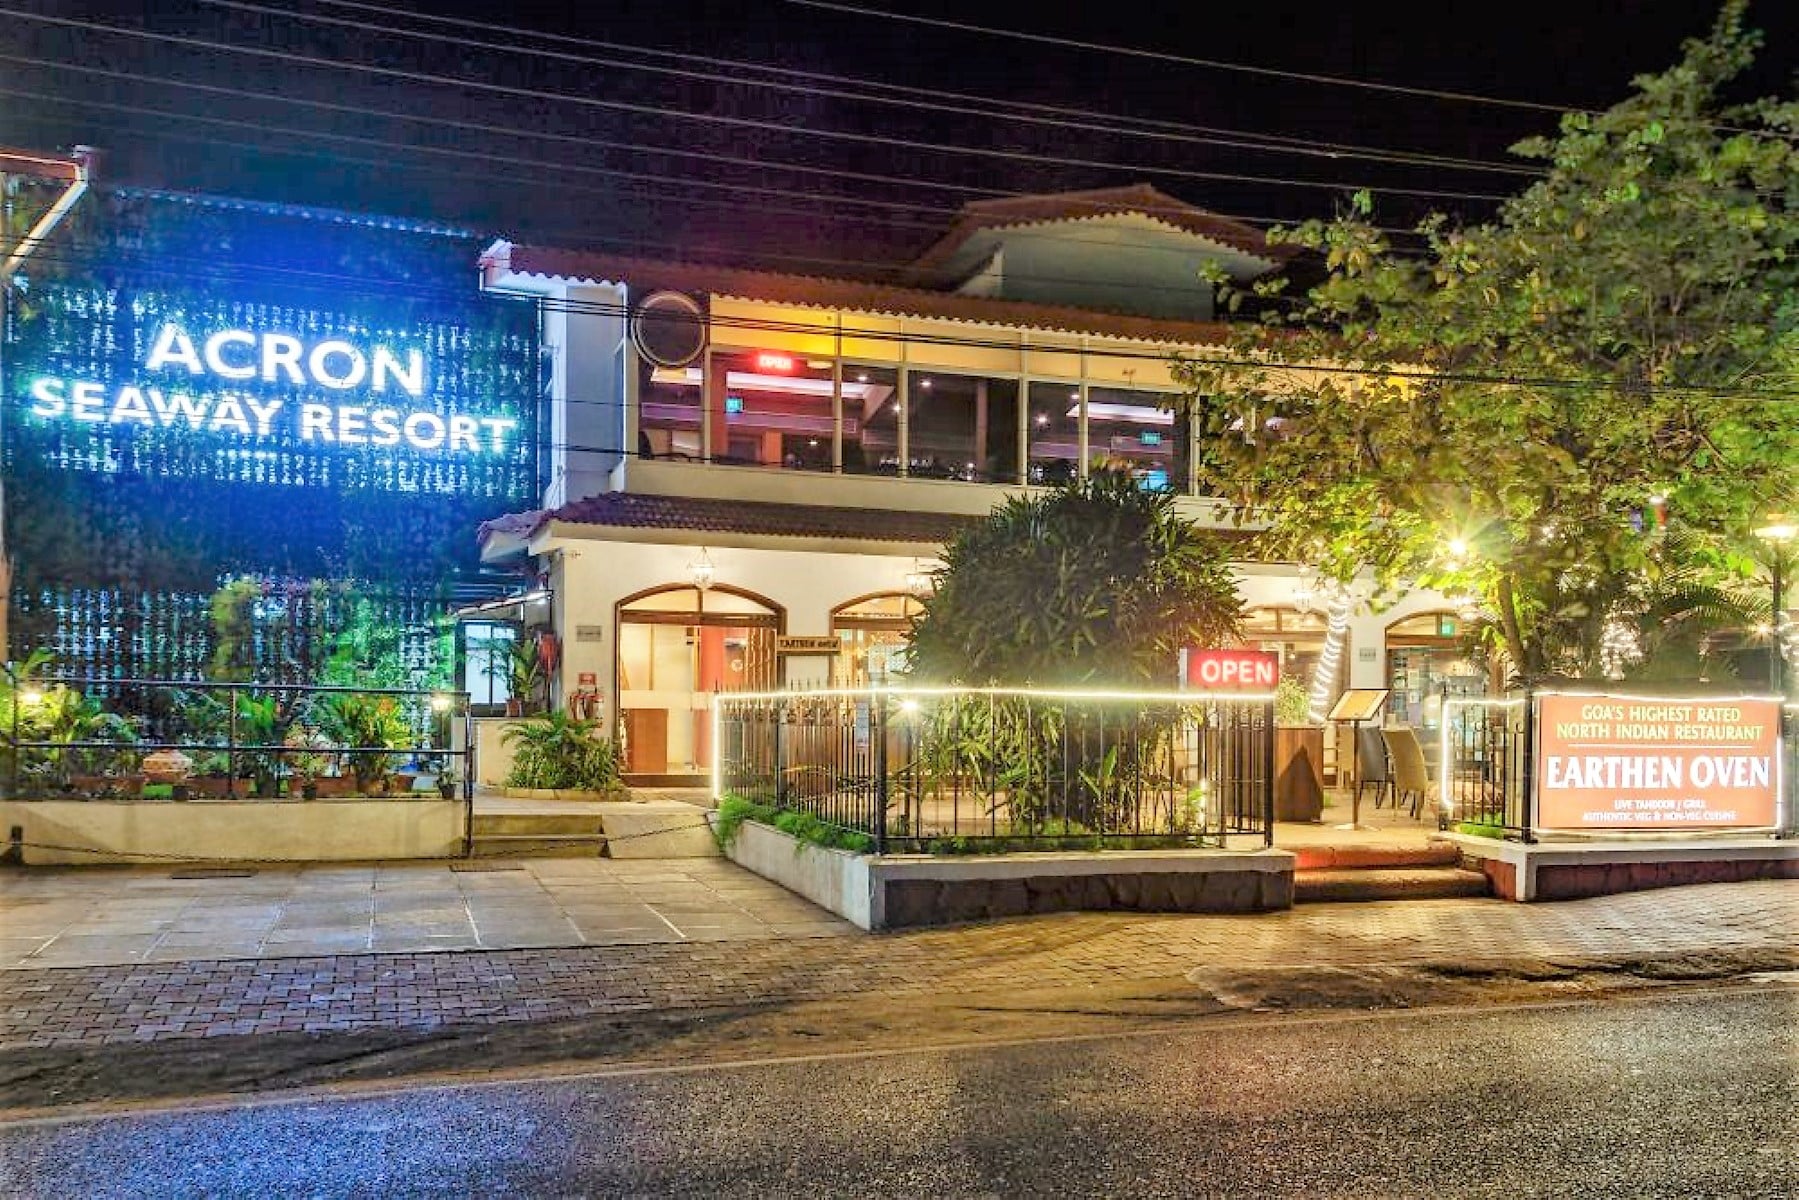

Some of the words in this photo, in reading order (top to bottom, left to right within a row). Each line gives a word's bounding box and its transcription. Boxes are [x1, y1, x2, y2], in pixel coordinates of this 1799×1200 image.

[146, 322, 425, 395] ACRON
[30, 376, 283, 436] SEAWAY
[301, 402, 518, 453] RESORT
[1201, 659, 1273, 683] OPEN
[1582, 705, 1623, 720] GOA'S
[1629, 706, 1692, 721] HIGHEST
[1697, 708, 1741, 722] RATED
[1557, 724, 1610, 739] NORTH
[1616, 724, 1668, 739] INDIAN
[1674, 725, 1764, 740] RESTAURANT
[1546, 756, 1683, 789] EARTHEN
[1689, 755, 1770, 789] OVEN
